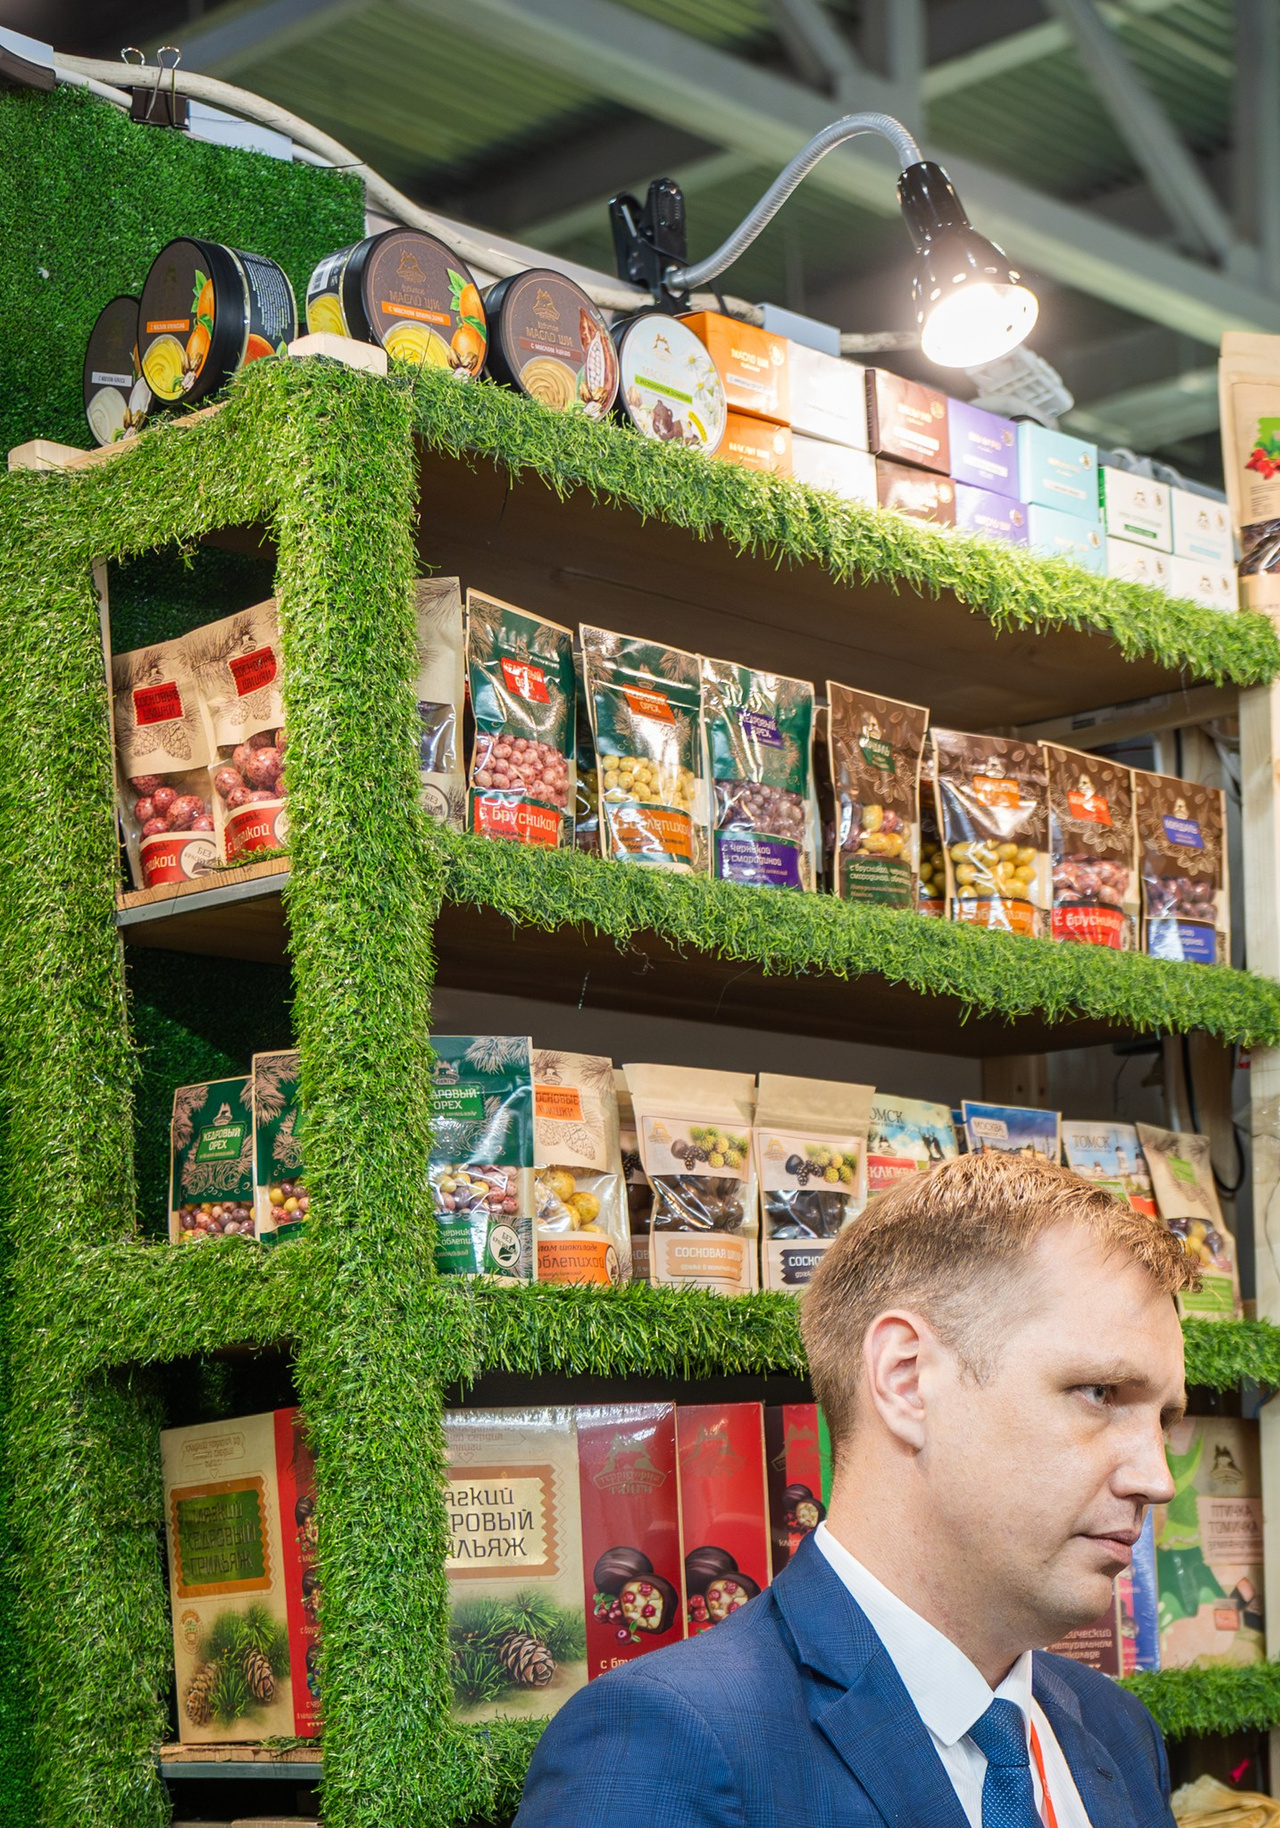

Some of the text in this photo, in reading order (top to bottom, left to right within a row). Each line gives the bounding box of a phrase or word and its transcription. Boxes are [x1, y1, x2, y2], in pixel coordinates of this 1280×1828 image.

[526, 326, 556, 343] МАСЛО
[492, 806, 558, 833] брусникой
[198, 846, 212, 858] БЕЗ
[731, 854, 782, 866] смородиной
[535, 1091, 579, 1105] ОСНОВЫЕ
[433, 1100, 463, 1111] ОРЕХ
[202, 1126, 242, 1142] КЕДРОВЫЙ
[208, 1140, 229, 1151] ОРЕХ
[1072, 1134, 1112, 1149] ТОМСК
[501, 1231, 513, 1243] БЕЗ
[675, 1246, 726, 1259] СОСНОВАЯ
[445, 1487, 514, 1506] ягкий
[451, 1509, 534, 1532] РОВЫЙ
[189, 1551, 253, 1577] ГРИЛЬЯЖ
